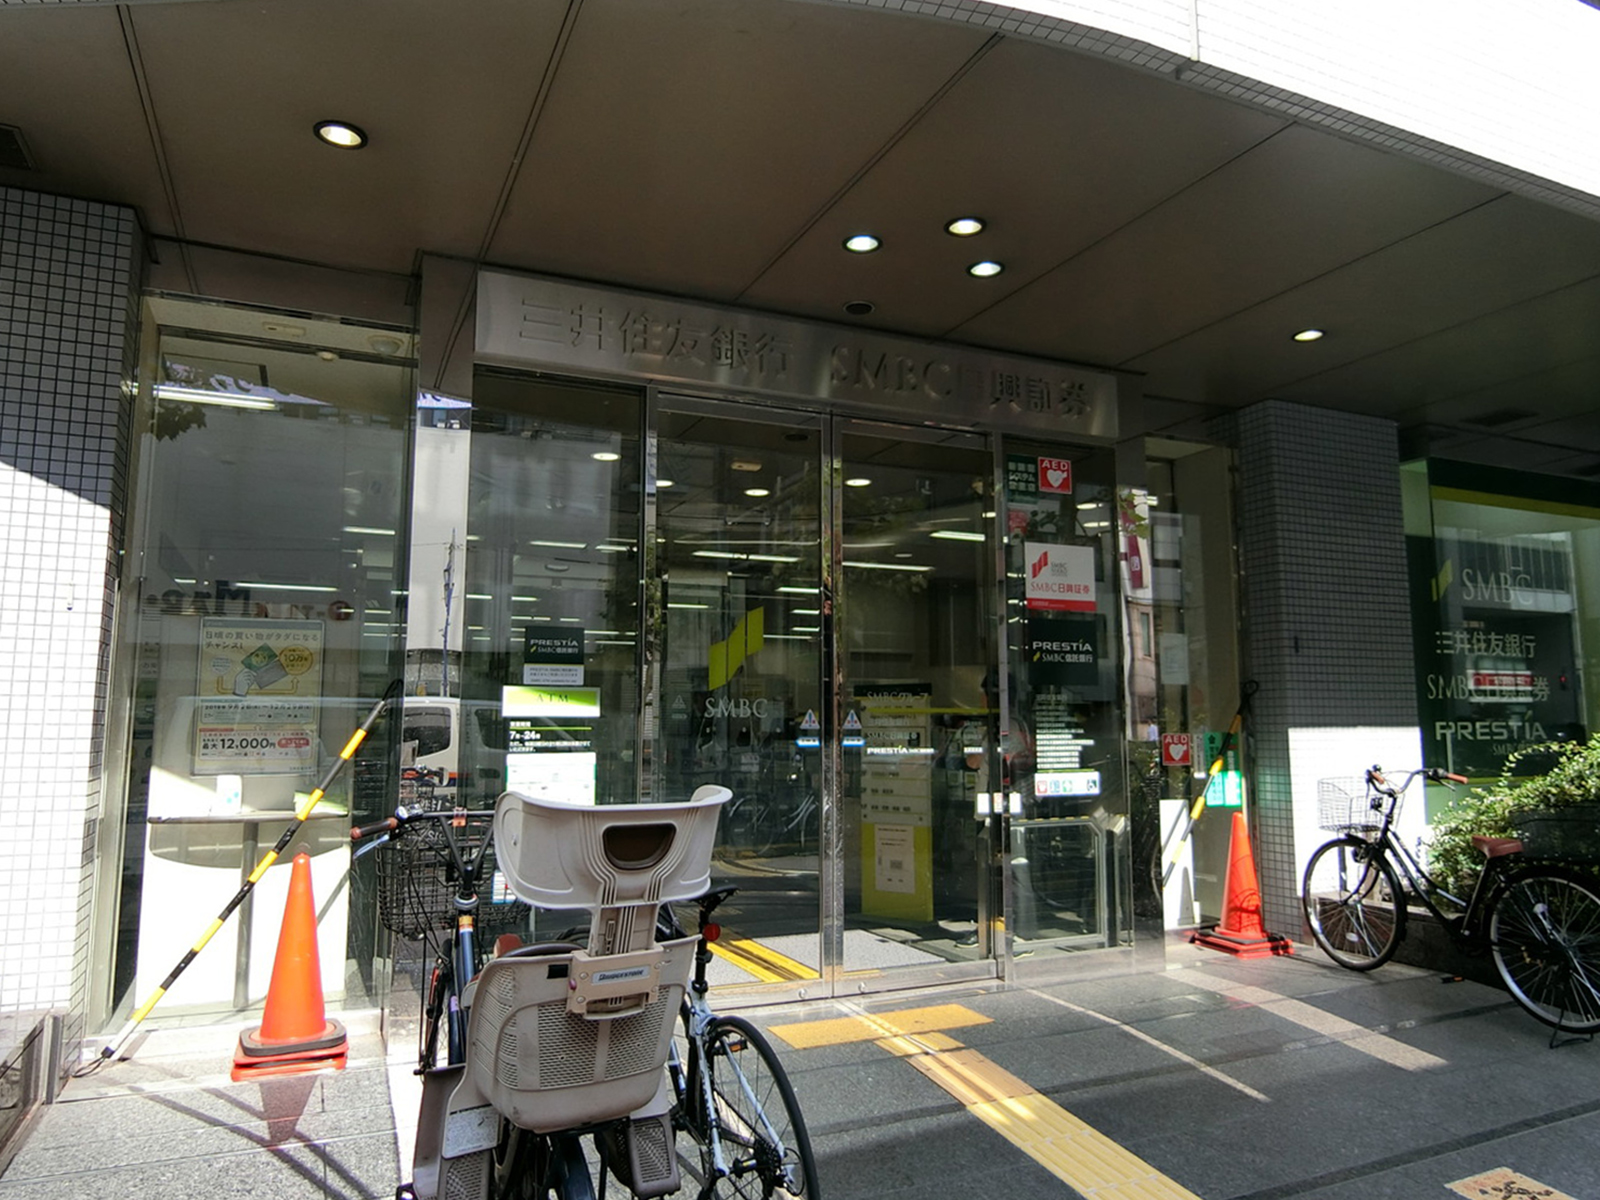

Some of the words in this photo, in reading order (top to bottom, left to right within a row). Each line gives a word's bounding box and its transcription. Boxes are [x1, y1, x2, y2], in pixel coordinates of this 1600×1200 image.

[519, 298, 794, 377] 三井住友銀行
[1041, 459, 1068, 471] AED
[1030, 581, 1090, 595] SMBC日興証券
[1461, 568, 1534, 606] SMBC
[1435, 630, 1537, 658] 三井住友銀行
[1041, 653, 1093, 663] SMBC信託銀行
[536, 693, 569, 703] ATM
[704, 697, 769, 718] SMBC
[1165, 735, 1188, 744] AED
